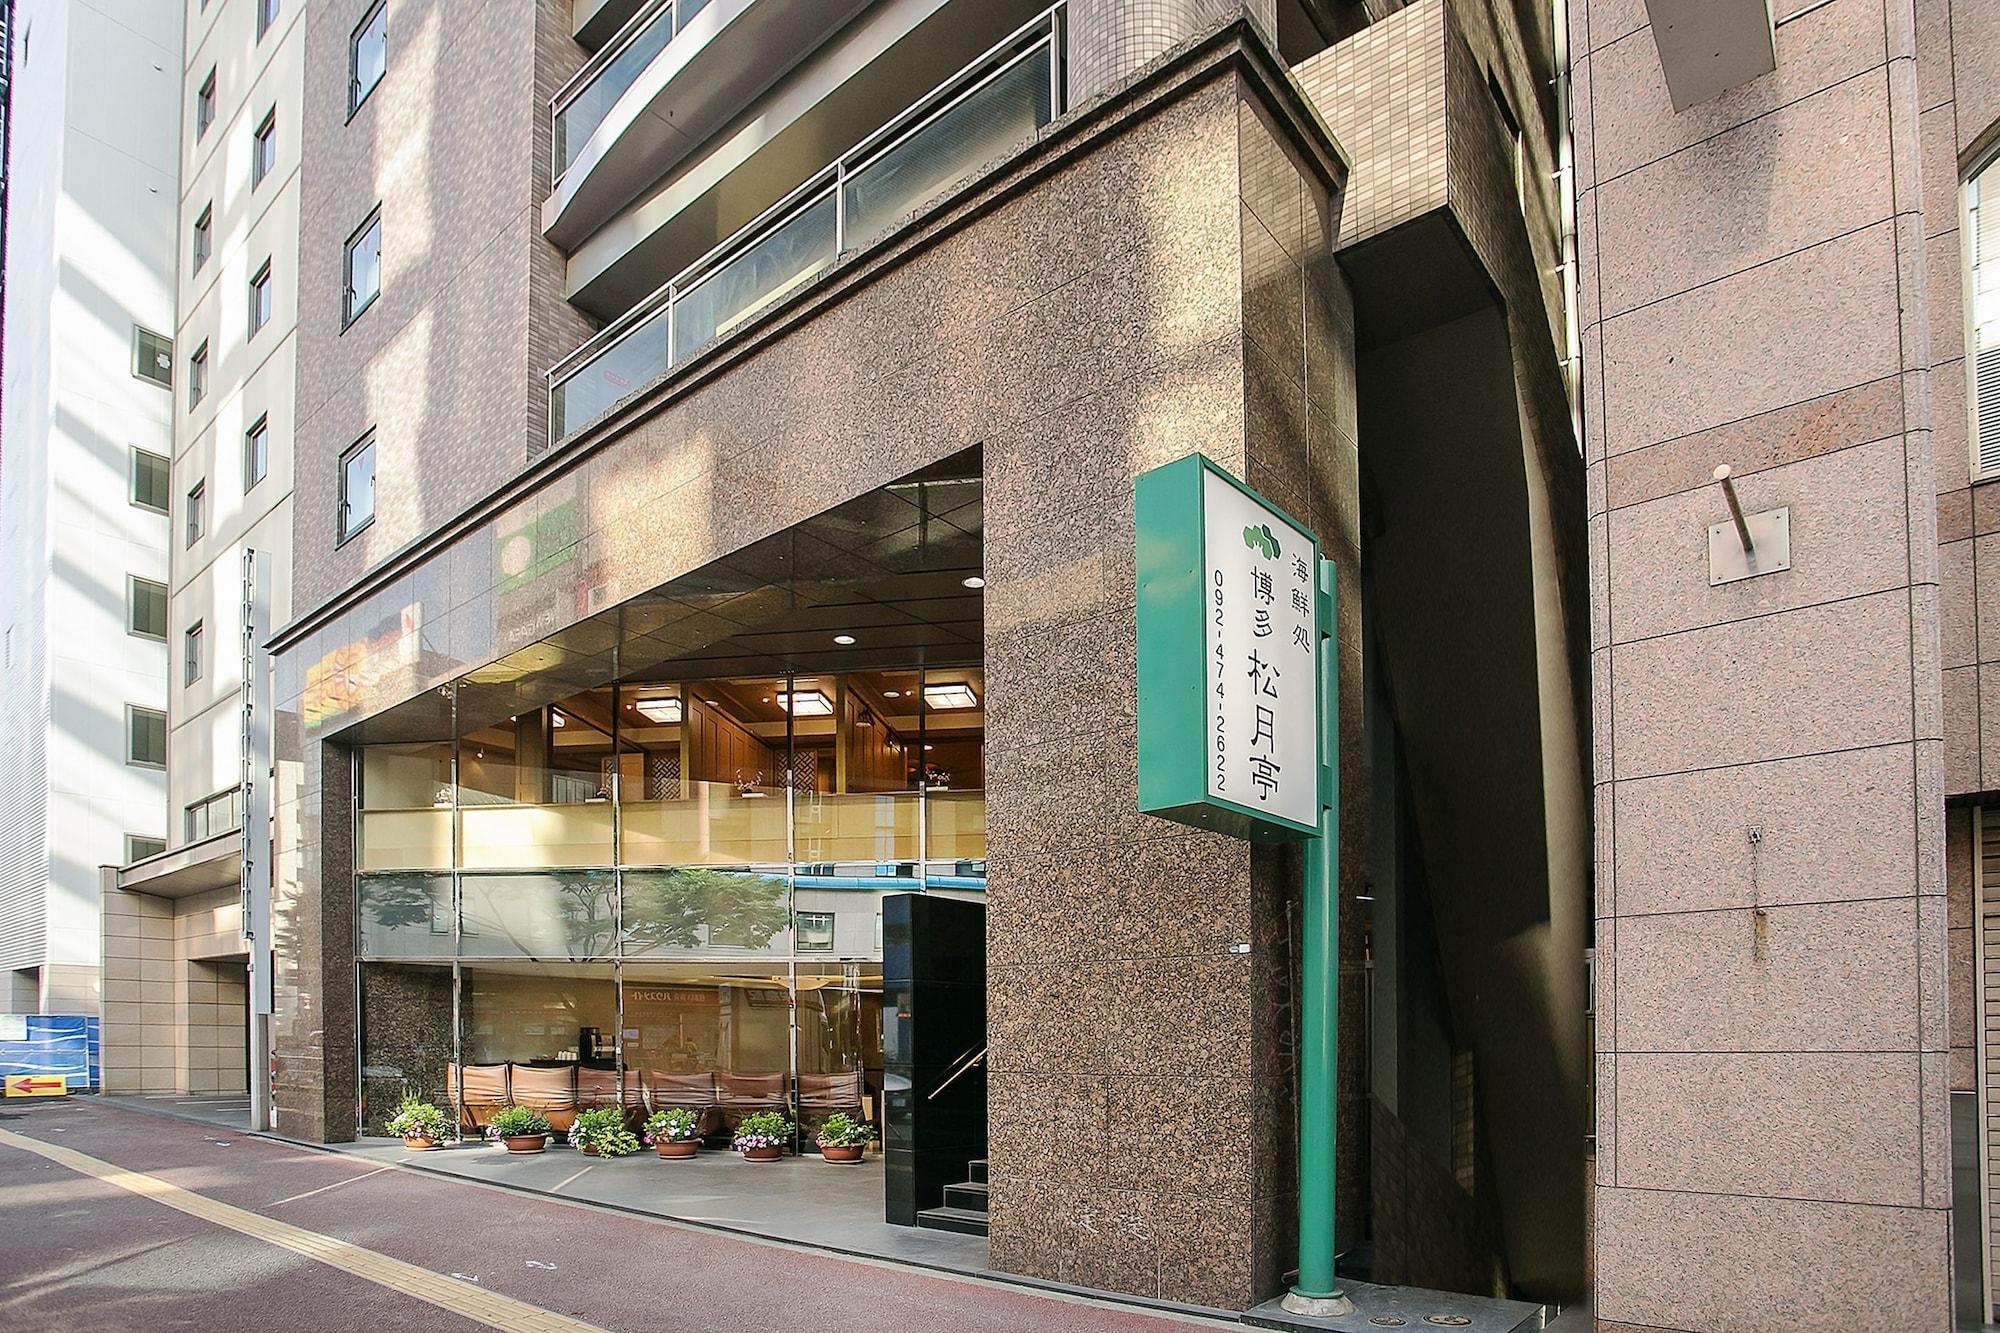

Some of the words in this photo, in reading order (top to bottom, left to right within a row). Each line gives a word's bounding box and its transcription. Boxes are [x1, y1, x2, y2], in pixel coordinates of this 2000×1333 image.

[1213, 568, 1226, 793] 092-474-2622
[1247, 565, 1281, 802] 博多松月亭
[1291, 551, 1311, 655] 海鮮処
